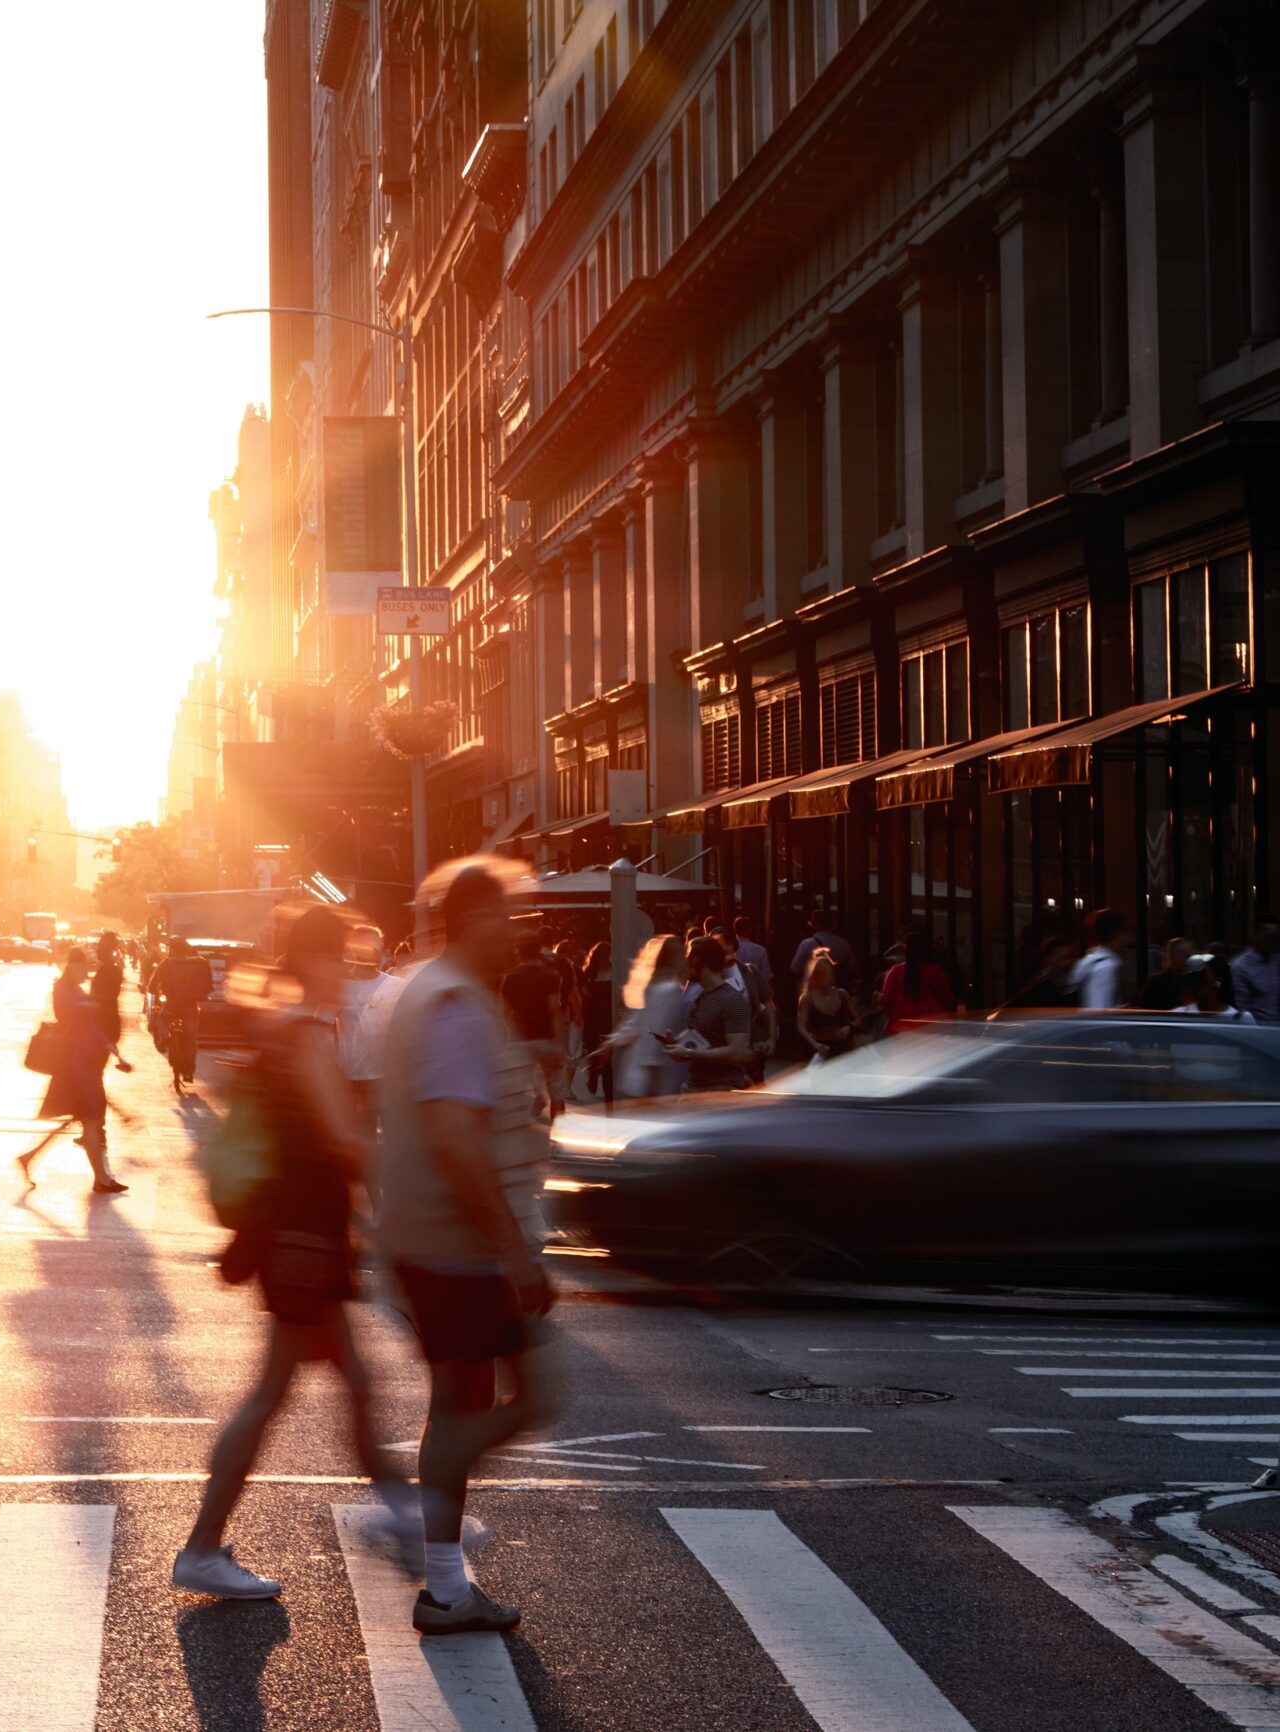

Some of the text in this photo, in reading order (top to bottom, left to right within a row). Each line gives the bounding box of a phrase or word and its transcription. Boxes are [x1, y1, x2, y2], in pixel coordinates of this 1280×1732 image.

[396, 589, 445, 599] BUS LANE
[380, 602, 446, 613] BUSES ONLY
